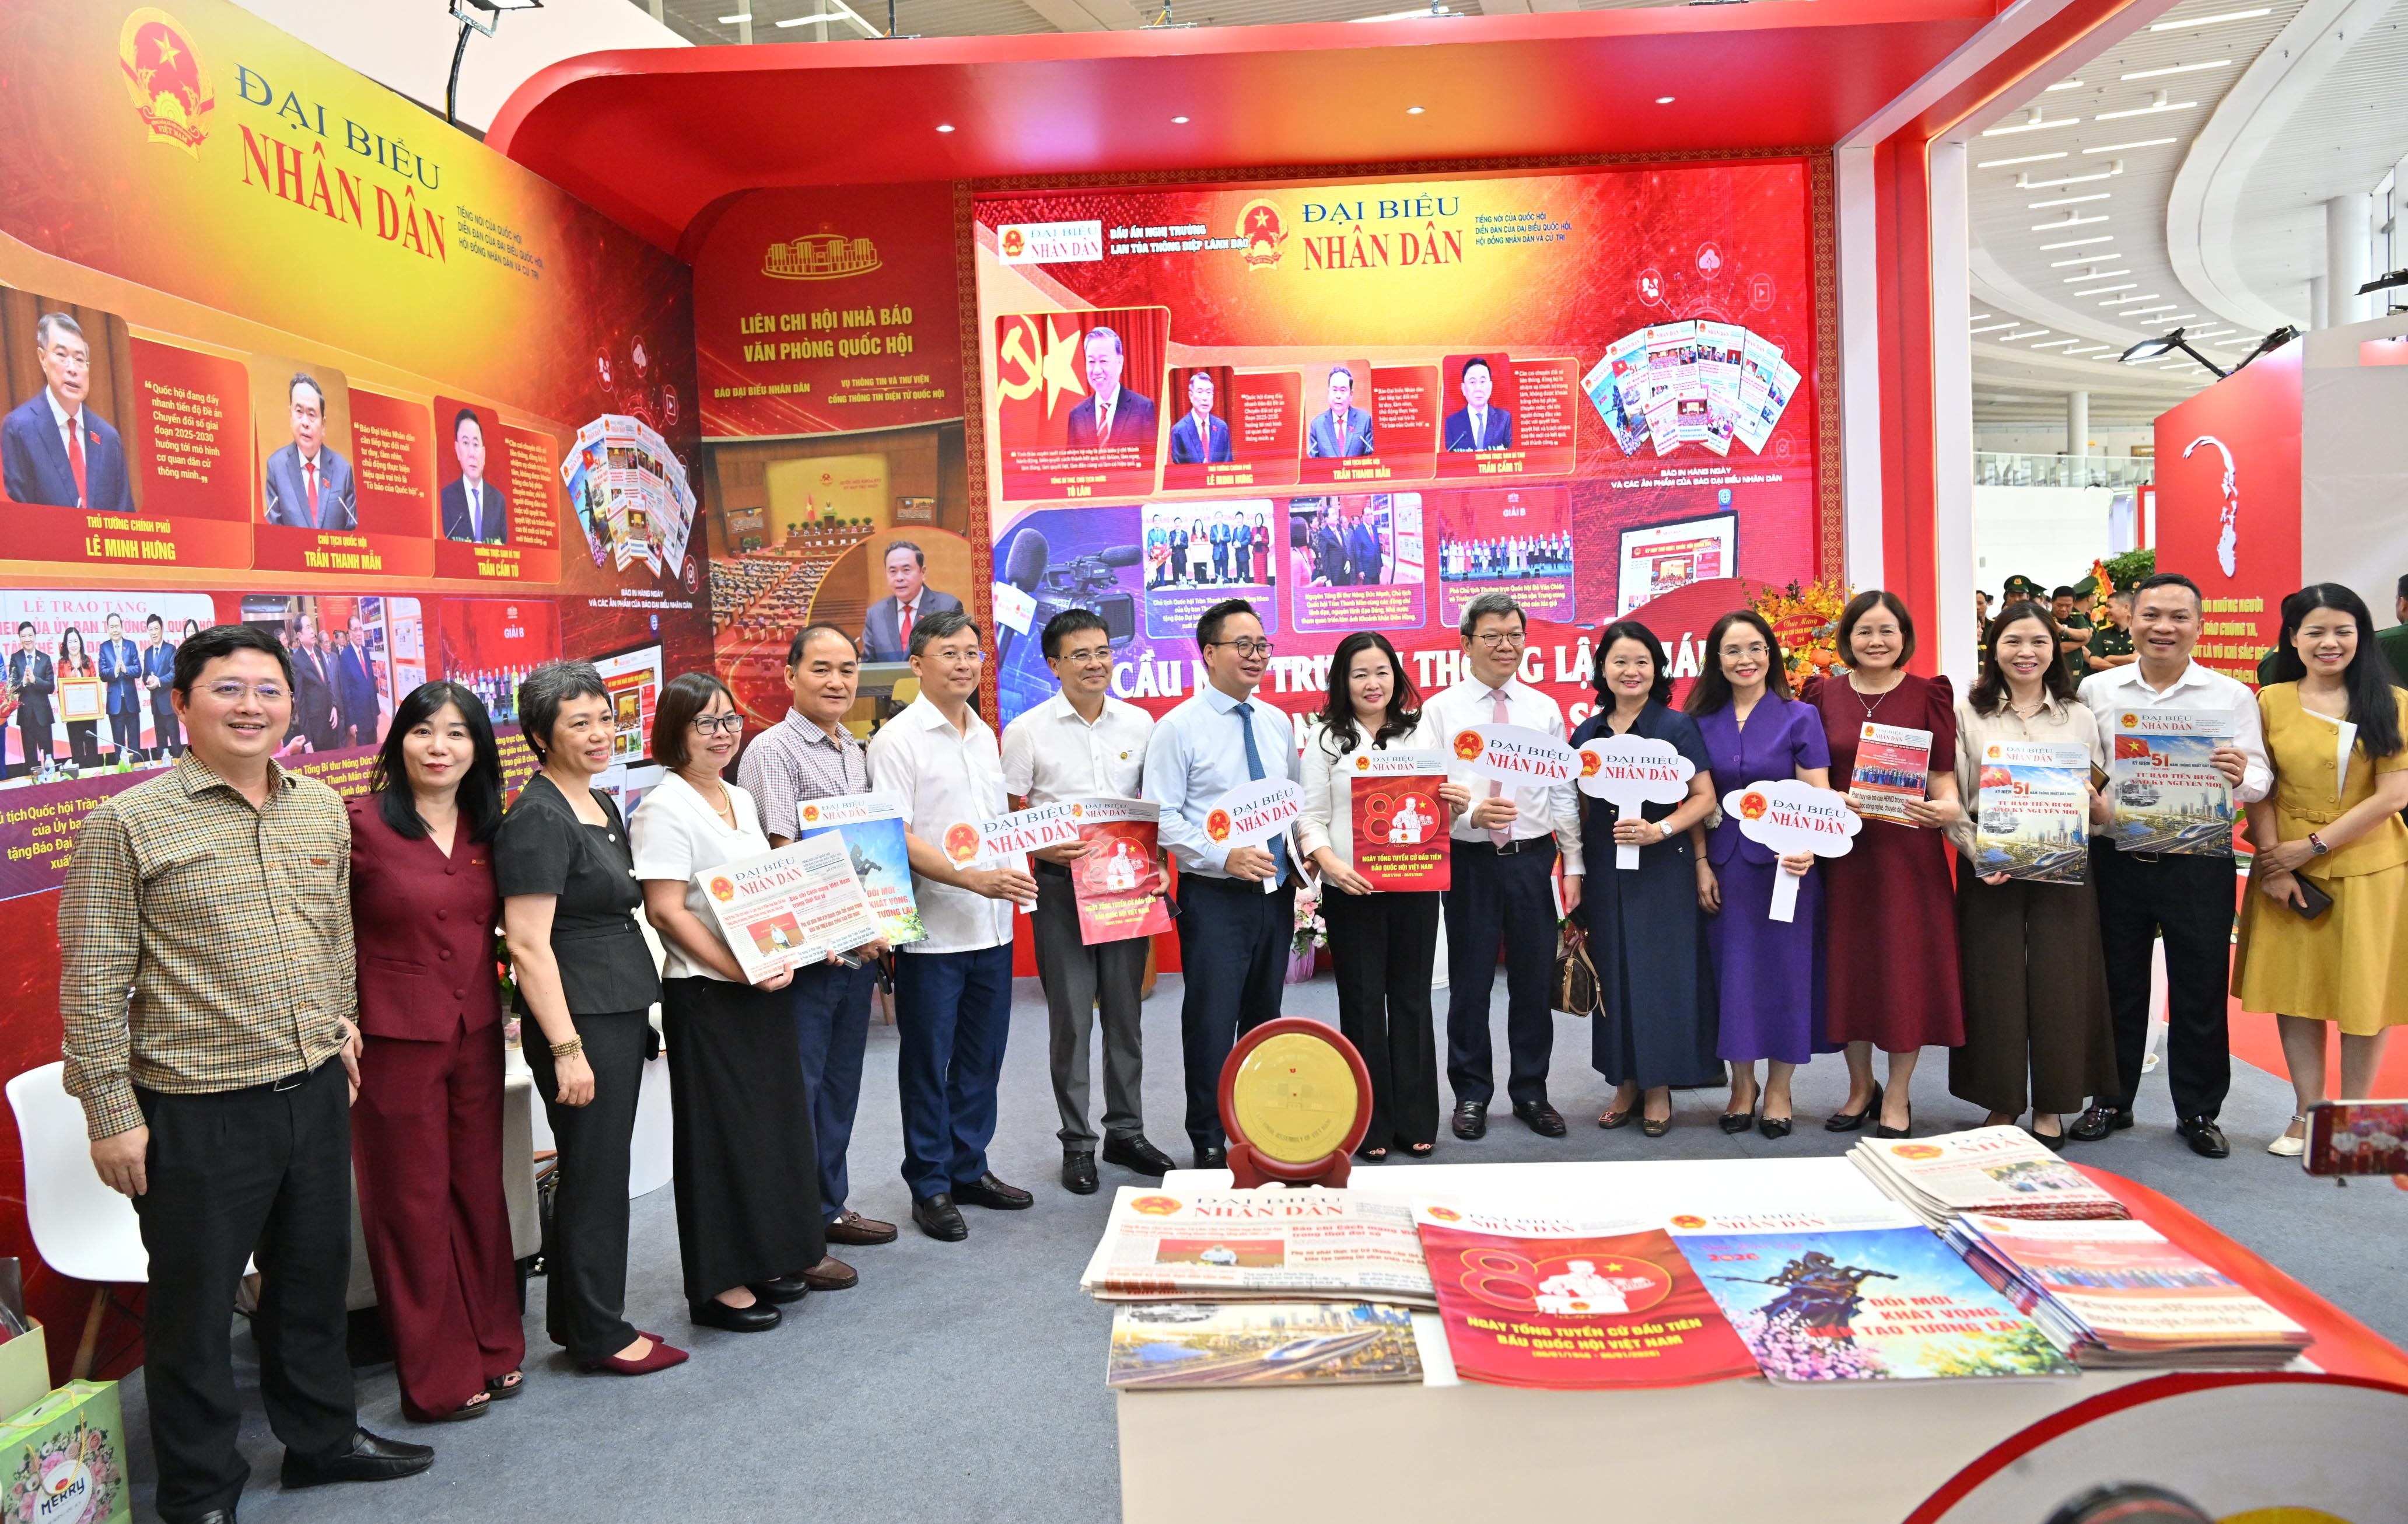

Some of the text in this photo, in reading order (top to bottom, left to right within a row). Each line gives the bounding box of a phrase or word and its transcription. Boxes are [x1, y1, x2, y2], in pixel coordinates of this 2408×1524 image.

[233, 62, 442, 191] ĐẠI BIỂU
[238, 123, 447, 264] NHÂN DÂN
[1302, 193, 1461, 225] ĐẠI BIỂU
[1475, 211, 1546, 223] TIẾNG NÓI CỦA QUỐC HỘI
[1303, 221, 1462, 270] NHÂN DÂN
[741, 304, 913, 334] LIÊN CHI HỘI NHÀ BÁO
[743, 331, 913, 362] VĂN PHÒNG QUỐC HỘI
[714, 382, 810, 398] BÁO ĐẠI BIỂU NHÂN DÂN
[841, 374, 930, 389] VỤ THÔNG TIN VÀ THƯ VIỆN
[174, 387, 185, 400] hội
[187, 390, 205, 404] đang
[206, 394, 219, 406] đẩy
[828, 387, 944, 404] CỔNG THÔNG TIN ĐIỆN TỬ QUỐC HỘI
[152, 397, 222, 418] nhanh tiến độ Đề án
[153, 411, 218, 431] Chuyển đổi số giai
[154, 425, 214, 442] đoạn 2025-2030
[155, 438, 220, 456] hướng tới mô hình
[168, 455, 186, 465] quan
[187, 456, 200, 466] dân
[202, 458, 212, 467] cử
[158, 466, 179, 479] thông
[86, 513, 170, 533] THỦ TƯỚNG CHÍNH PHỦ
[86, 534, 176, 560] LÊ MINH HƯNG
[317, 532, 367, 549] CHỦ TỊCH QUỐC HỘI
[304, 547, 382, 570] TRẦN THANH MẪN
[2213, 596, 2264, 613] NHỮNG NGƯỜI
[504, 624, 524, 638] GIẢI B
[2219, 620, 2246, 636] CHÚNG
[2246, 623, 2258, 637] TA,
[2203, 642, 2254, 659] LÀ VŨ KHÍ SẮC
[1111, 648, 1181, 698] CẦU
[2141, 721, 2169, 730] NHÂN
[2172, 721, 2192, 730] DÂN
[1489, 739, 1571, 761] ĐẠI BIỂU
[1373, 762, 1395, 770] NHÂN
[1398, 761, 1415, 770] DÂN
[1486, 751, 1569, 780] NHÂN DÂN
[1606, 755, 1678, 765] ĐẠI BIỂU
[2151, 753, 2169, 767] 51
[1605, 764, 1679, 781] NHÂN DÂN
[6, 797, 98, 824] tịch Quốc hội Trần
[1233, 788, 1293, 816] ĐẠI BIỂU
[1772, 800, 1846, 818] ĐẠI BIỂU
[32, 817, 66, 837] của Ủy
[984, 805, 1072, 833] ĐẠI BIỂU
[1236, 800, 1297, 835] NHÂN DÂN
[1769, 811, 1845, 836] NHÂN DÂN
[986, 819, 1079, 857] NHÂN DÂN
[7, 836, 72, 861] tặng Báo Đại
[1377, 854, 1391, 862] TỔNG
[1418, 852, 1429, 861] ĐẦU
[1383, 863, 1397, 871] QUỐC
[1409, 863, 1419, 871] VIỆT
[1868, 1295, 1954, 1306] ĐỔI MỚI
[1860, 1319, 2022, 1336] TẠO TƯƠNG LAI
[41, 1477, 84, 1515] MERRY
